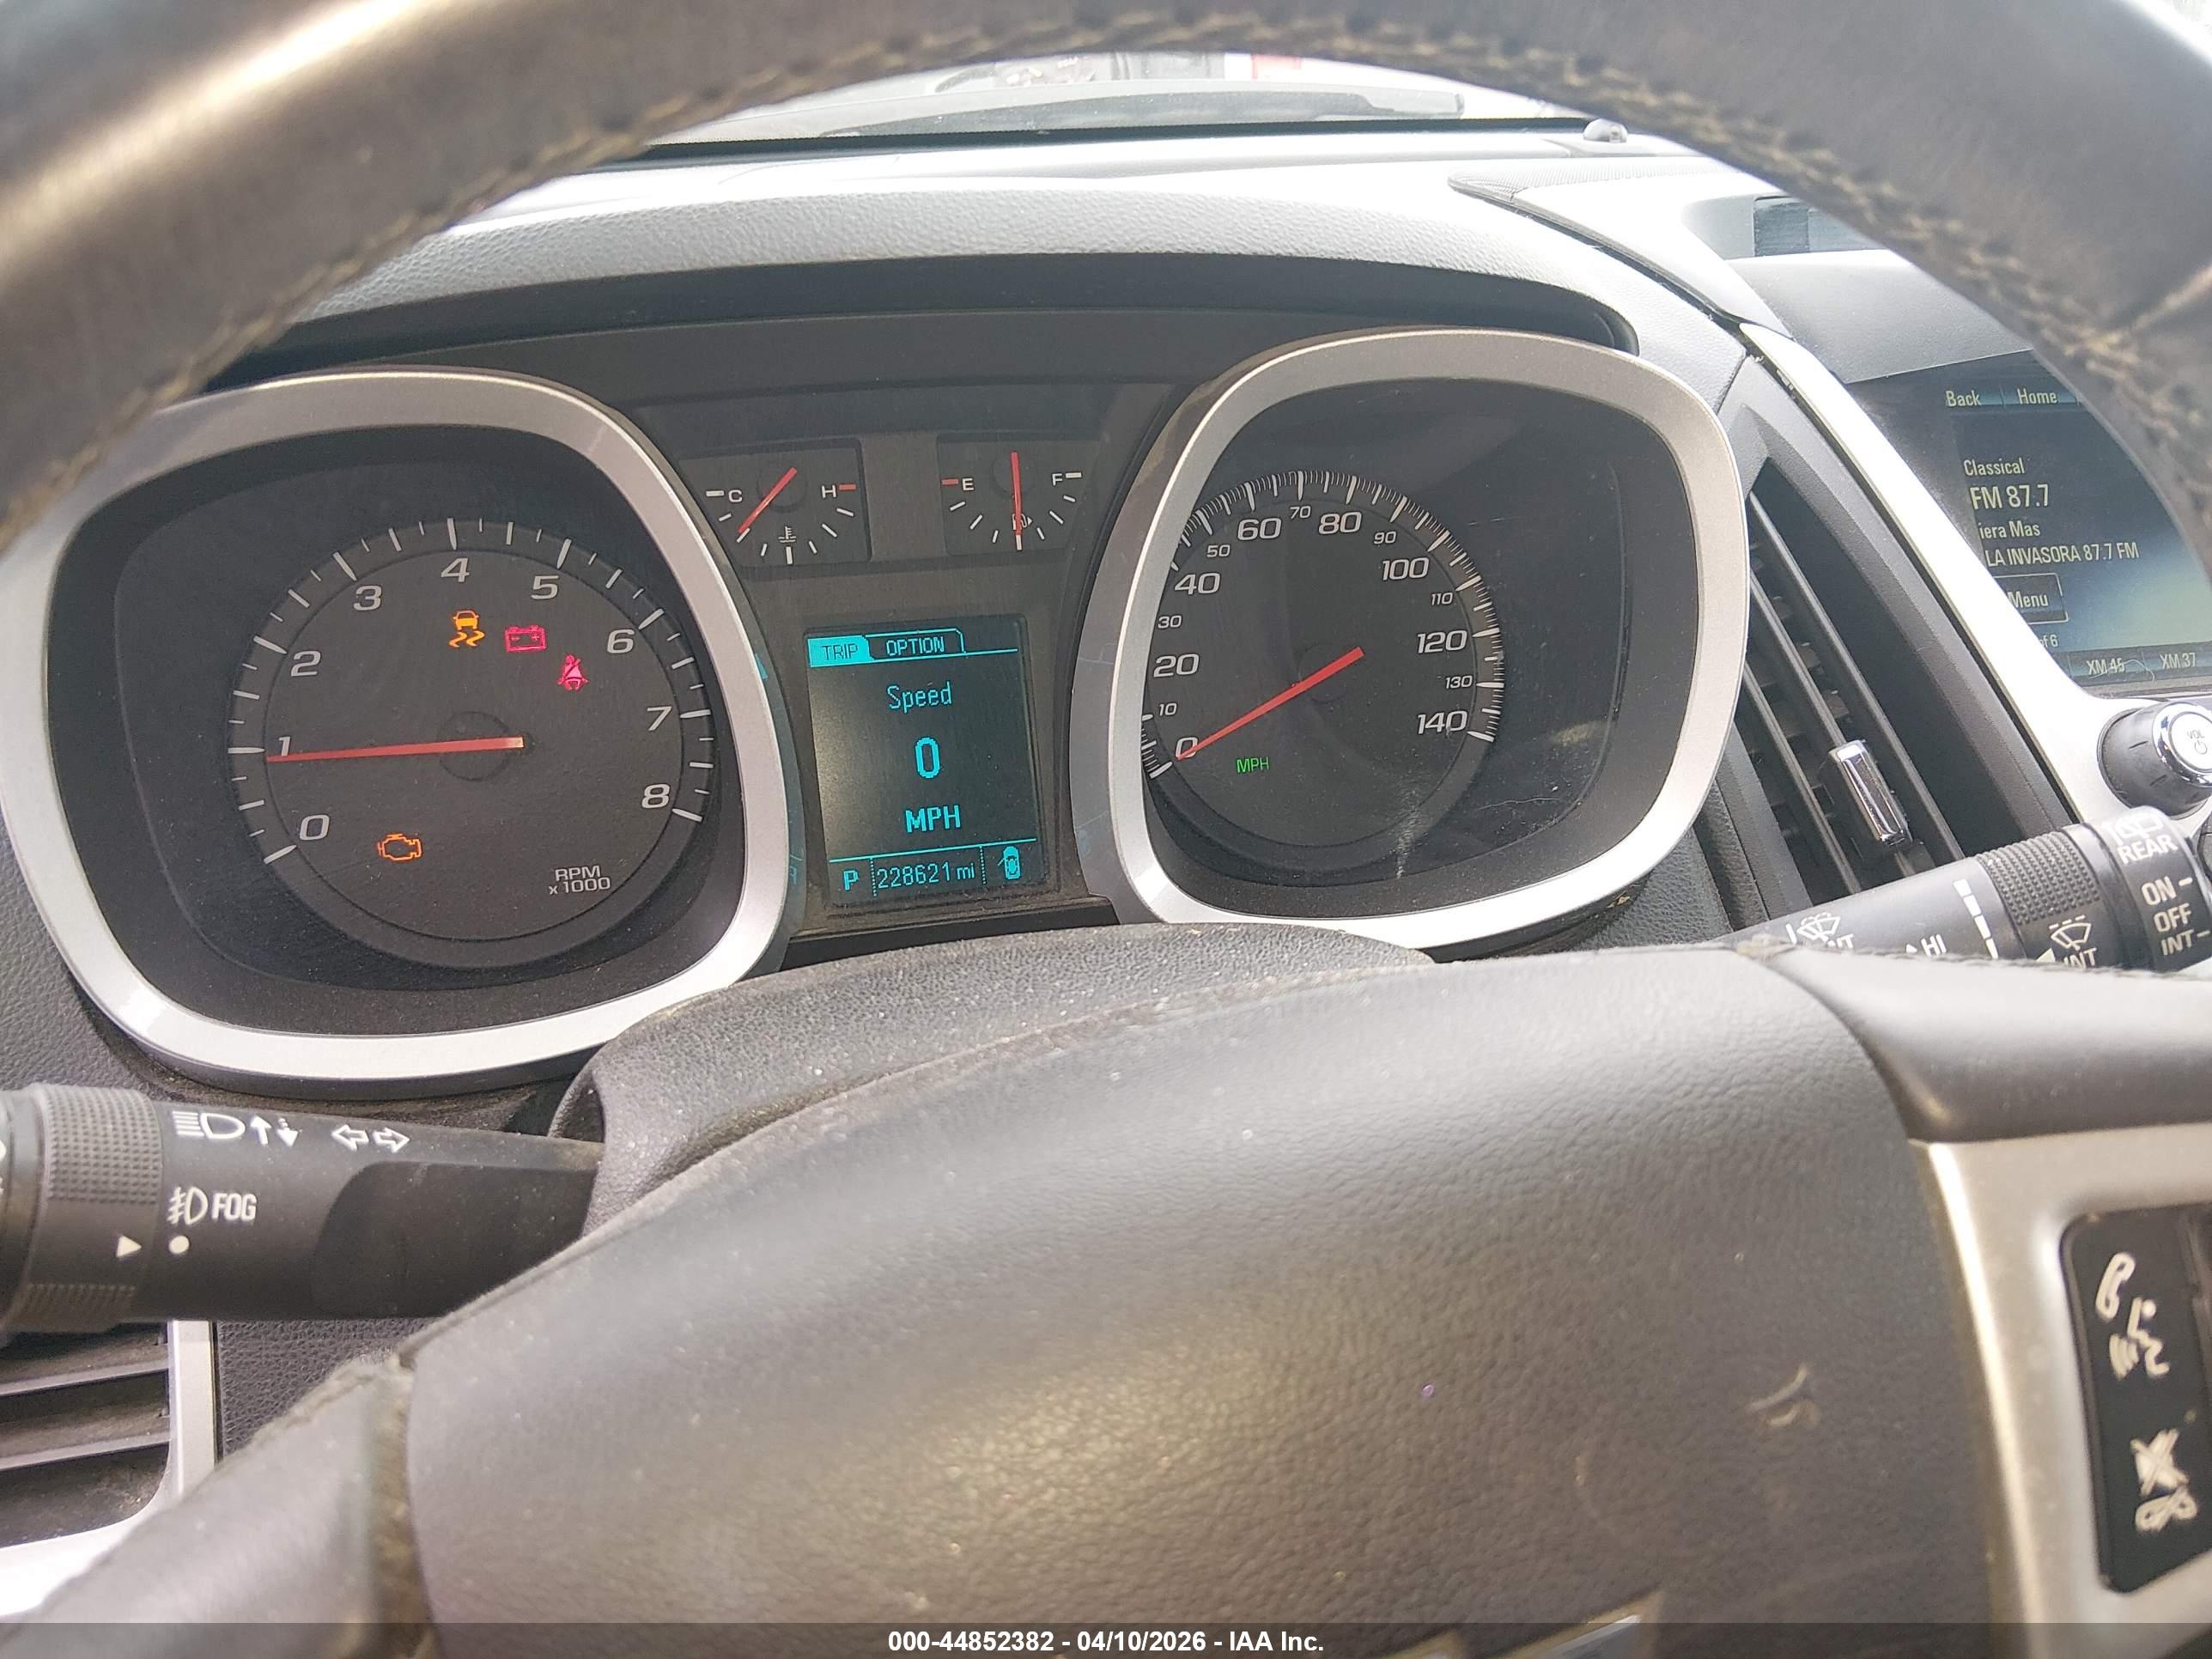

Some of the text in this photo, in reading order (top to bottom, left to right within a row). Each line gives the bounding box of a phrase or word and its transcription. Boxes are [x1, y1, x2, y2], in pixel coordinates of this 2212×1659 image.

[1946, 390, 1982, 407] Back
[2017, 388, 2057, 404] Home
[1964, 458, 2025, 477] Classical
[962, 478, 975, 490] E
[1052, 473, 1063, 485] F
[728, 489, 743, 502] C
[822, 484, 837, 498] H
[1970, 483, 2049, 509] FM 87.7
[1290, 506, 1311, 519] 70
[1318, 512, 1363, 535] 80
[1237, 517, 1282, 540] 60
[1373, 531, 1397, 544] 90
[1978, 520, 2040, 538] iera Mas
[1206, 544, 1231, 558] 50
[1985, 542, 2140, 567] LA INVASORA 87.7 FM
[441, 557, 471, 583] 4
[1382, 557, 1429, 580] 100
[531, 574, 560, 599] 5
[1175, 573, 1222, 595] 40
[353, 585, 382, 611] 3
[1431, 592, 1453, 605] 110
[2008, 592, 2048, 608] Menu
[1158, 615, 1182, 629] 30
[606, 629, 635, 653] 6
[885, 635, 945, 656] OPTION
[1417, 630, 1468, 653] 120
[2050, 634, 2057, 647] 6
[822, 644, 859, 661] TRIP
[2160, 653, 2196, 669] XM 37
[290, 651, 321, 677] 2
[1153, 653, 1200, 678] 20
[2087, 658, 2124, 675] XM 45
[1445, 675, 1473, 689] 130
[887, 681, 952, 714] Speed
[646, 706, 672, 731] 7
[1159, 702, 1177, 716] 10
[1417, 711, 1468, 734] 140
[277, 736, 291, 757] 1
[1175, 737, 1198, 759] 0
[915, 737, 941, 779] 0
[1236, 757, 1270, 773] MPH
[641, 784, 671, 809] 8
[299, 813, 331, 841] 0
[905, 805, 961, 833] MPH
[2118, 835, 2178, 865] REAR
[555, 865, 600, 881] RPM
[843, 869, 859, 890] P
[876, 863, 975, 889] 228621 mi
[2141, 876, 2177, 906] ON
[2154, 903, 2191, 933] OFF
[1920, 933, 1948, 957] HI
[2160, 929, 2194, 956] INT
[212, 1193, 257, 1221] FOG
